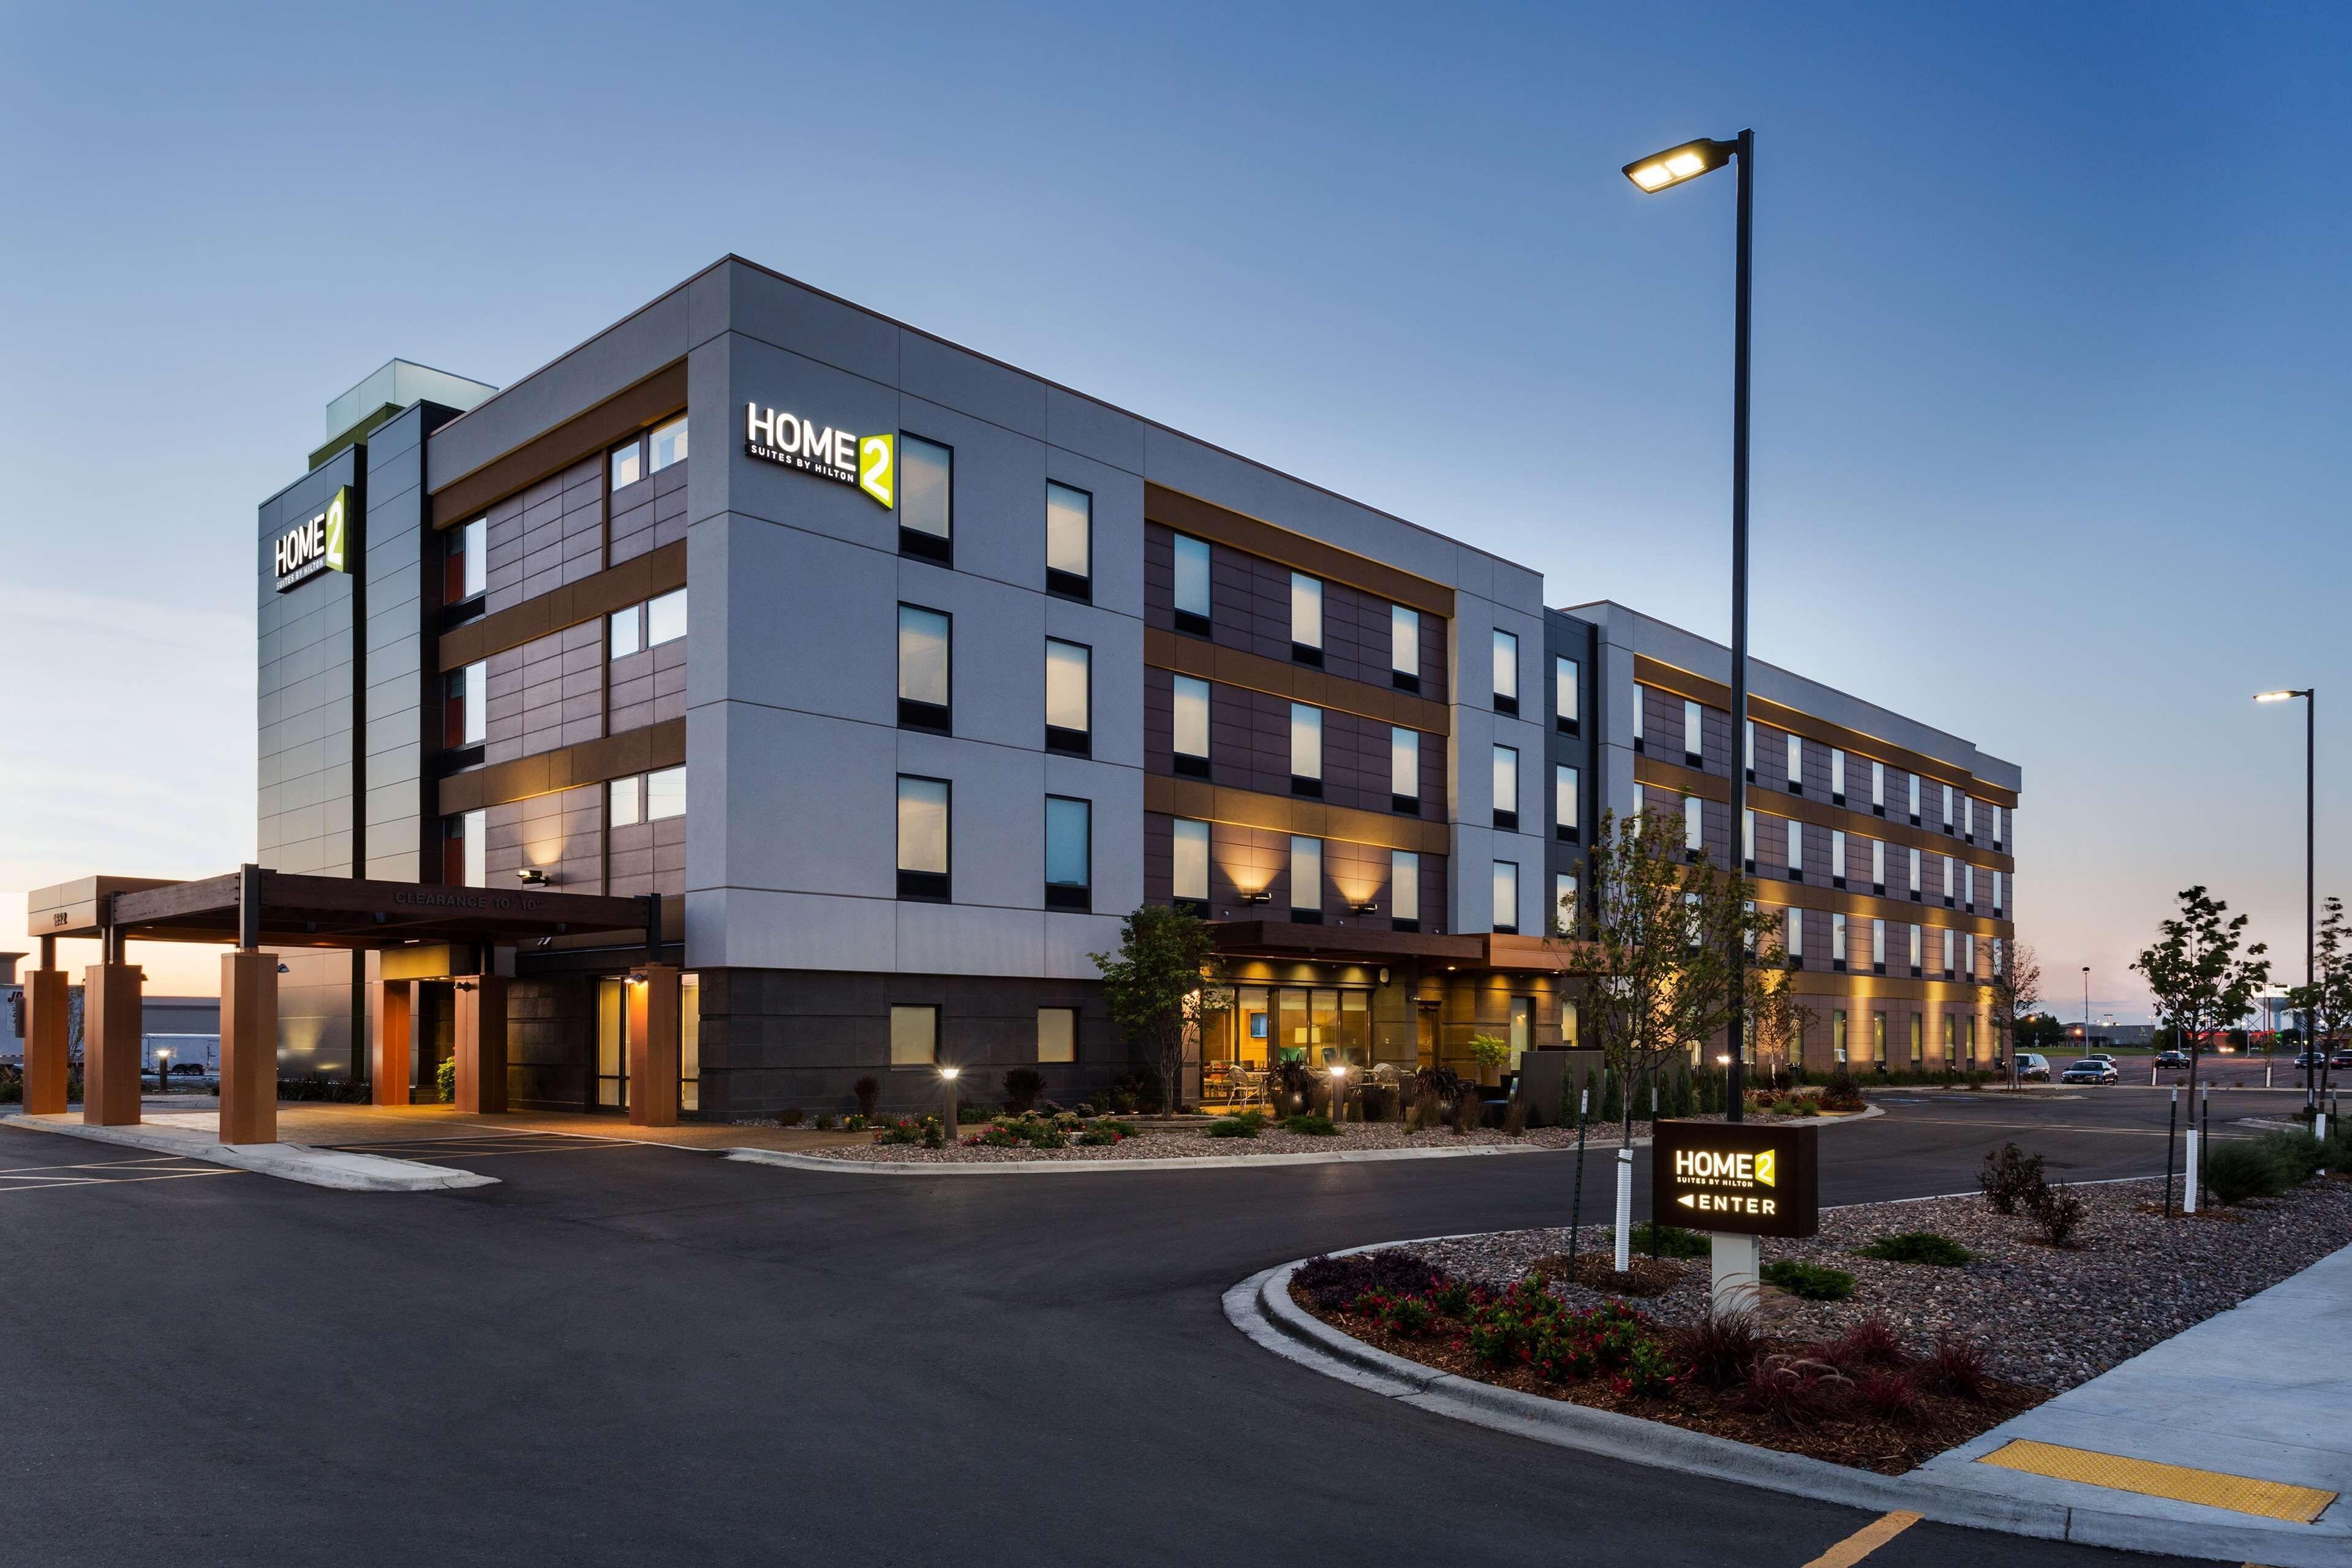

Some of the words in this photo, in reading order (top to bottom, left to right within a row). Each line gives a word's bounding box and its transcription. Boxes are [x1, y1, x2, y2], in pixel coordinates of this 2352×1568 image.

[751, 444, 792, 464] SUITES
[796, 458, 811, 470] BY
[815, 464, 854, 483] HILTON
[276, 574, 294, 590] SUITES
[296, 570, 303, 579] BY
[304, 558, 323, 575] HILTON
[395, 892, 486, 908] CLEARANCE
[1676, 1176, 1706, 1185] SUITES
[1722, 1179, 1753, 1188] HILTON
[1699, 1194, 1775, 1215] ENTER
